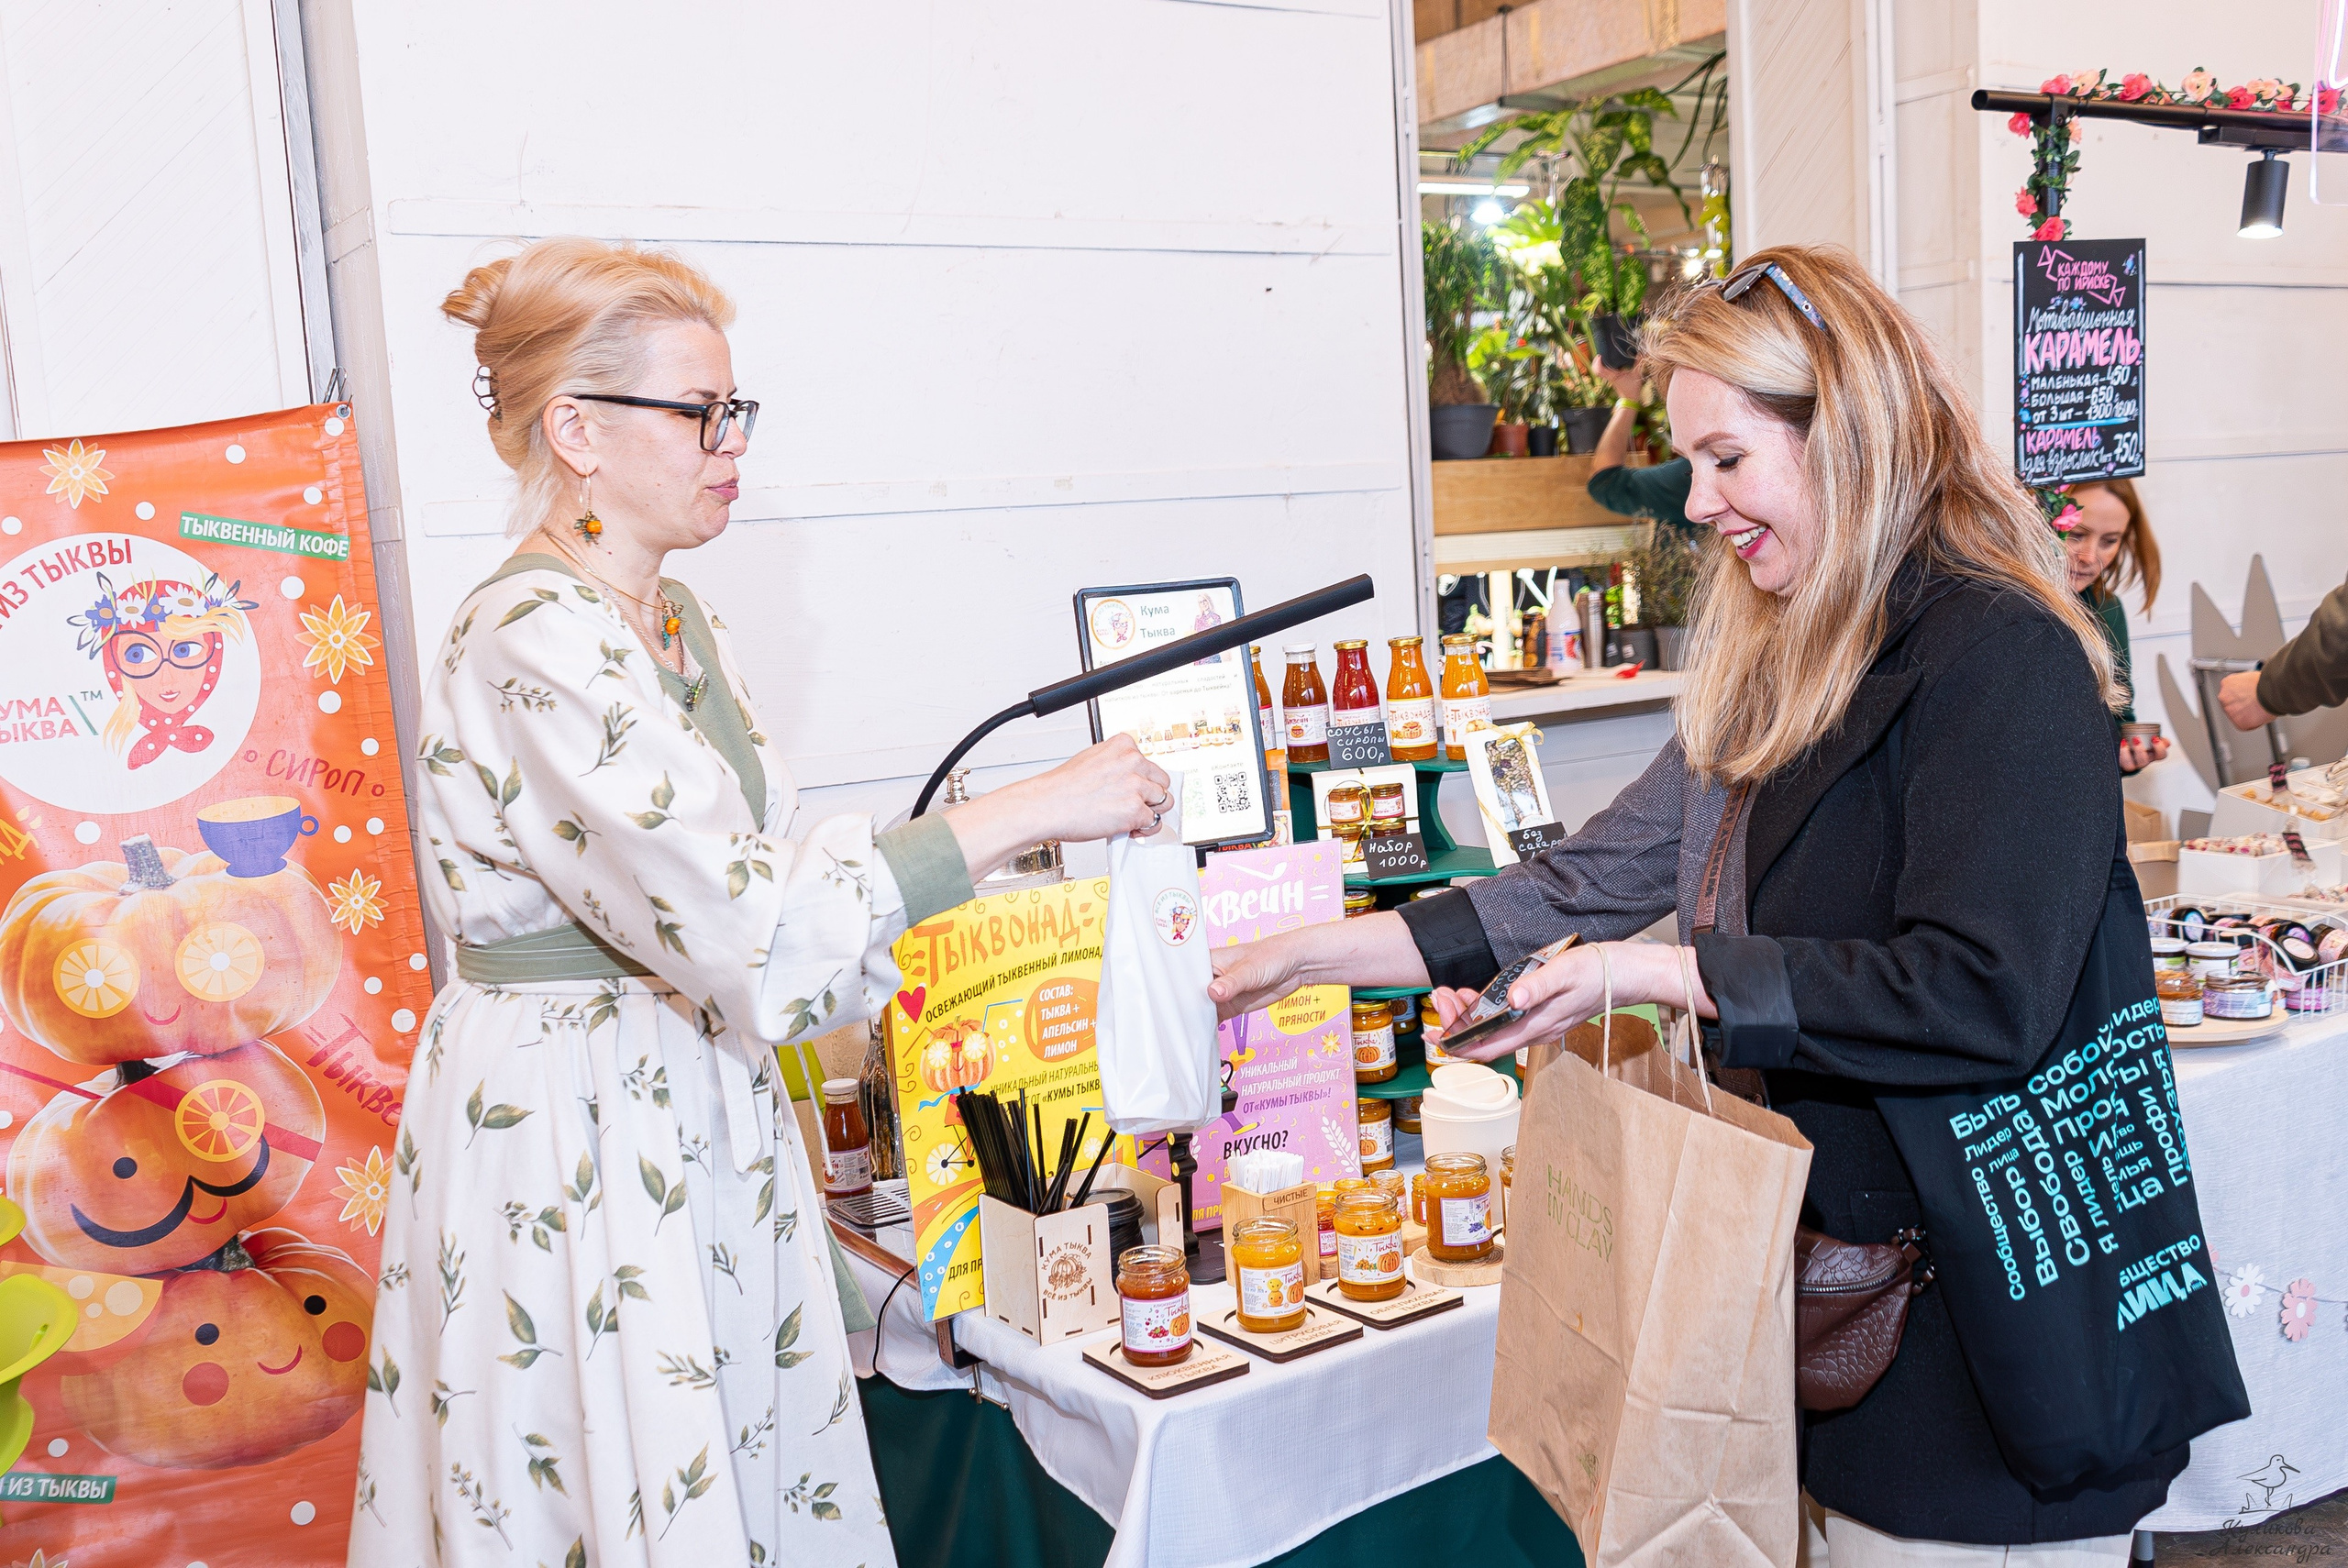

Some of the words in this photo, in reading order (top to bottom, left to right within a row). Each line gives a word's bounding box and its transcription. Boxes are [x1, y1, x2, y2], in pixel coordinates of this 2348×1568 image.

[2057, 260, 2110, 277] КАЖДОМУ
[2057, 276, 2071, 292] ПО
[2023, 327, 2141, 374] КАРАМЕЛЬ
[2026, 426, 2102, 455] КАРАМЕЛЬ
[181, 516, 295, 550] ТЫКВЕННЫЙ
[298, 532, 349, 558] КОФЕ
[20, 538, 132, 590] ТЫКВЫ
[1140, 605, 1169, 617] Кума
[1140, 627, 1176, 638] Тыква
[266, 749, 365, 796] СИРОП
[1523, 829, 1543, 842] без
[1368, 840, 1412, 855] Набор
[925, 974, 996, 1023] ОСВЕЖАЮЩИЙ
[997, 952, 1058, 986] ТЫКВЕННЫЙ
[1039, 984, 1074, 1002] СОСТАВ:
[1277, 994, 1312, 1010] ЛИМОН
[2110, 996, 2161, 1029] идер
[1040, 1007, 1071, 1021] ТЫКВА
[1279, 1010, 1326, 1028] ПРЯНОСТИ
[1041, 1018, 1089, 1041] АПЕЛЬСИН
[1043, 1040, 1078, 1059] ЛИМОН
[2027, 1023, 2112, 1095] собой
[1239, 1057, 1299, 1079] УНИКАЛЬНЫЙ
[1077, 1078, 1102, 1095] ТЫКВ
[1241, 1074, 1301, 1097] НАТУРАЛЬНЫЙ
[1302, 1068, 1342, 1087] ПРОДУКТ
[1223, 1130, 1289, 1160] ВКУСНО?
[1273, 1188, 1308, 1205] ЧИСТЫЕ
[1548, 1164, 1612, 1235] HANDS
[2012, 1109, 2091, 1267] Свобода
[1192, 1208, 1204, 1221] ЛЯ
[1547, 1192, 1563, 1225] IN
[2005, 1165, 2059, 1287] Выбор
[1041, 1246, 1062, 1270] КУМА
[1064, 1242, 1092, 1260] ТЫКВА
[948, 1262, 969, 1282] ДЛЯ
[970, 1257, 982, 1274] ПР
[1268, 1320, 1344, 1344] ЦИТРУСОВАЯ
[1295, 1329, 1337, 1342] ТЫКВА
[1147, 1353, 1232, 1381] КЛЮКВЕННАЯ
[1176, 1364, 1221, 1378] ТЫКВА
[7, 1477, 34, 1496] ИЗ
[37, 1478, 108, 1499] ТЫКВЫ
